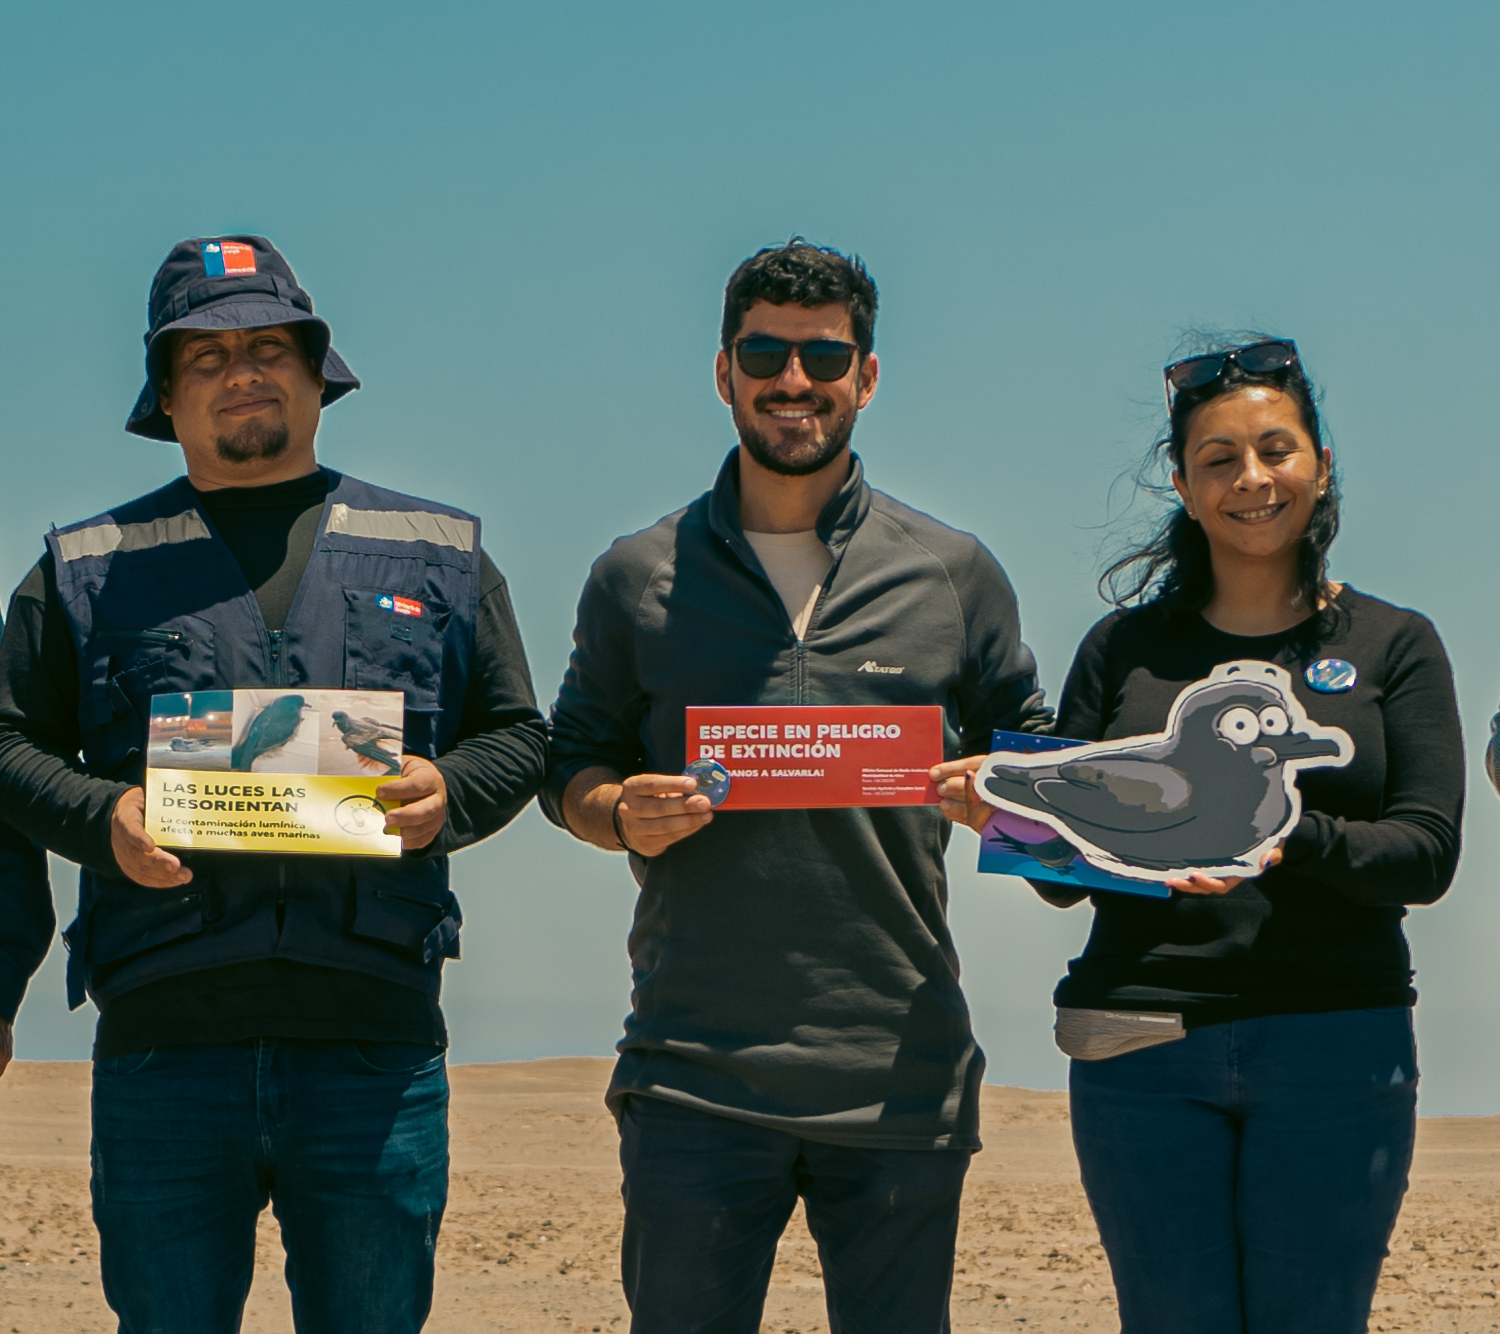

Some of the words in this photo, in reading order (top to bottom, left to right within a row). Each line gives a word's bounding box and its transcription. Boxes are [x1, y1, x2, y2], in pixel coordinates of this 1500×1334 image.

[700, 725, 778, 740] ESPECIE
[784, 724, 810, 739] EN
[817, 724, 901, 739] PELIGRO
[700, 744, 725, 759] DE
[731, 740, 841, 759] EXTINCIÓN
[761, 769, 769, 777] A
[771, 769, 825, 777] SALVARLA!
[163, 782, 197, 795] LAS
[204, 784, 265, 797] LUCES
[272, 786, 306, 798] LAS
[162, 797, 299, 813] DESORIENTAN
[176, 818, 257, 828] contaminación
[259, 820, 306, 829] lumínica
[160, 825, 193, 835] afecta
[206, 828, 248, 837] muchas
[250, 830, 275, 838] aves
[277, 831, 321, 840] marinas
